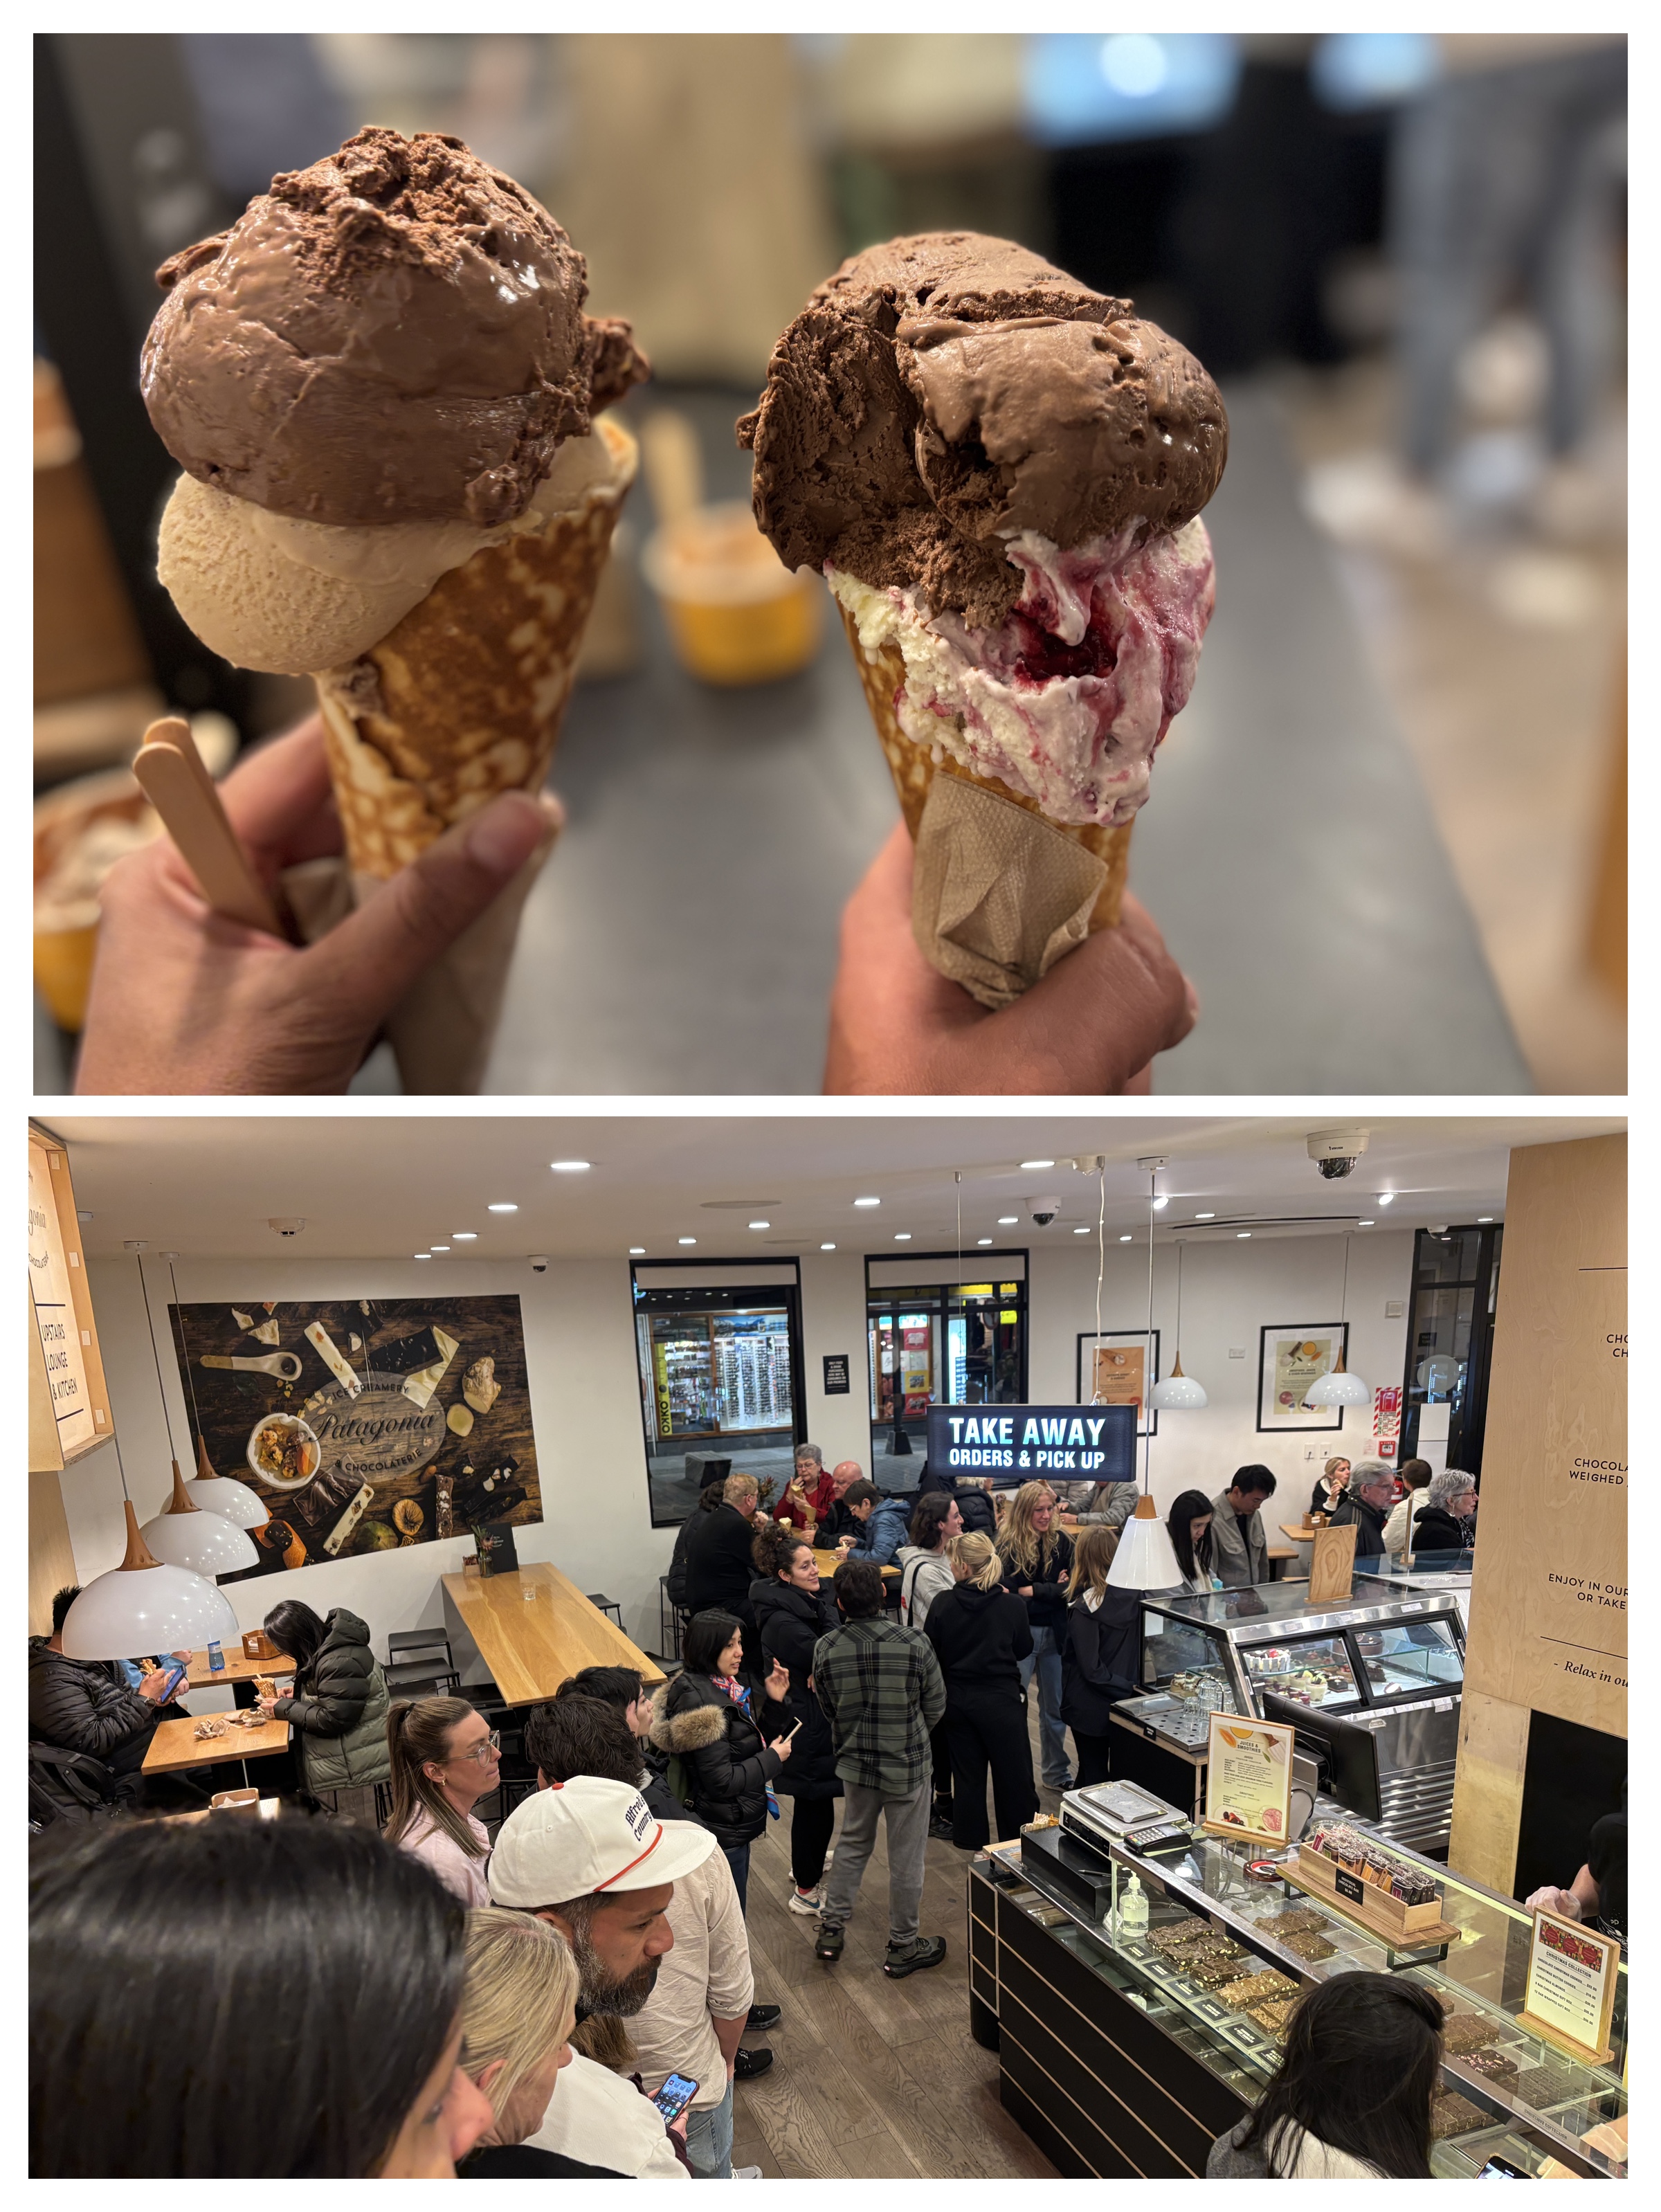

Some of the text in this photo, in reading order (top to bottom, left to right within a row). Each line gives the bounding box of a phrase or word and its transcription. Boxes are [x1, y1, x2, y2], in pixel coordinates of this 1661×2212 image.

[42, 1324, 65, 1341] UPSTAIRS
[46, 1352, 68, 1370] LOUNGE
[53, 1378, 78, 1400] & KITCHEN
[332, 1384, 409, 1399] ICE CREAMERY
[309, 1410, 435, 1445] Patagonia
[949, 1417, 1106, 1446] TAKE AWAY
[345, 1448, 421, 1471] CHOCOLATERIE
[949, 1449, 1105, 1469] ORDERS & PICK UP
[1570, 1470, 1624, 1485] WEIGHED
[1549, 1573, 1584, 1588] ENJOY
[1589, 1581, 1600, 1591] IN
[1577, 1592, 1626, 1610] OR TAKE
[1564, 1661, 1597, 1679] Relax
[1599, 1670, 1611, 1683] in
[1237, 1744, 1261, 1753] SMOOTHIES
[626, 1795, 645, 1829] Alfred's
[634, 1811, 652, 1842] Country
[1338, 1878, 1354, 1889] CHOCOLATE
[1538, 1957, 1553, 1968] CHOCOLATE
[1553, 1966, 1570, 1977] CHRISTMAS
[1570, 1974, 1583, 1984] COOKIES
[1546, 1951, 1568, 1966] CHRISTMAS
[1568, 1963, 1592, 1978] COLLECTION
[1536, 1966, 1552, 1977] CHRISTMAS
[1553, 1974, 1563, 1982] BUTTER
[1564, 1980, 1577, 1989] COOKIES
[1536, 1973, 1552, 1984] CHRISTMAS
[1543, 1986, 1559, 1997] CHRISTMAS
[1543, 1995, 1557, 2005] WRAPPED
